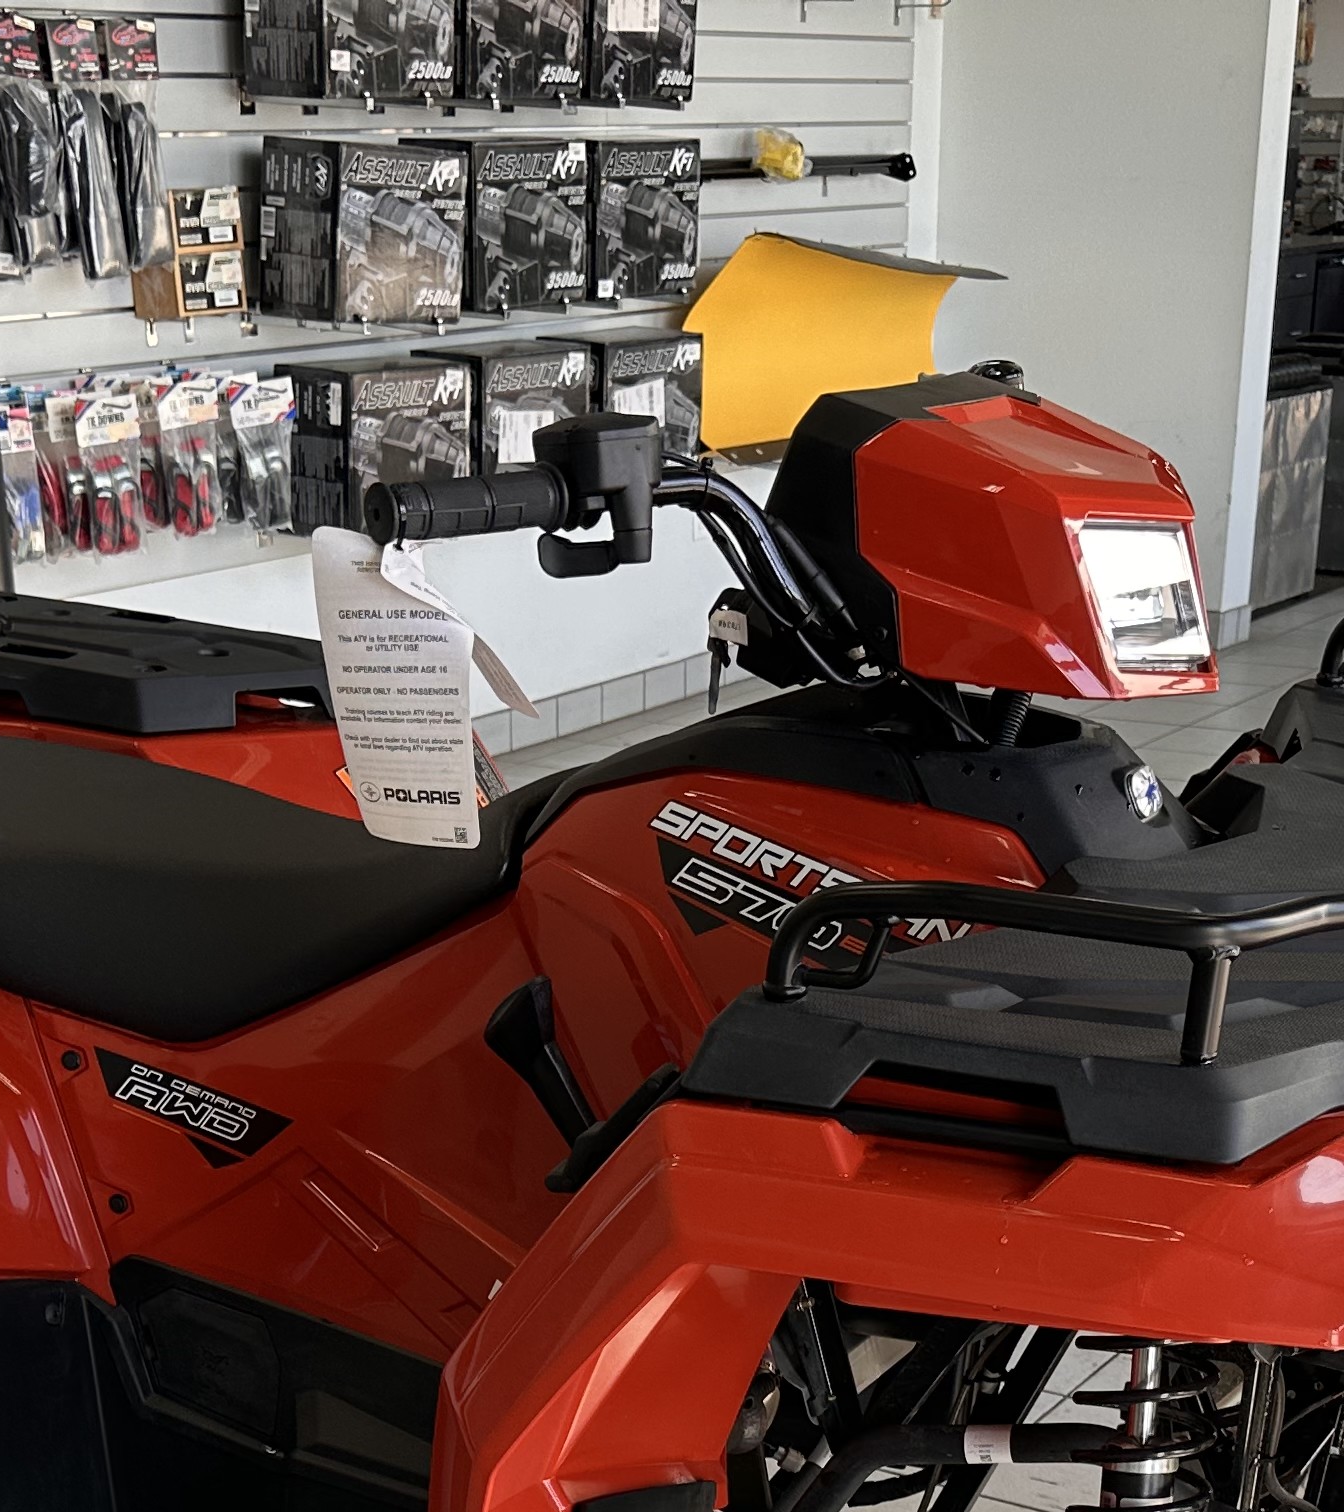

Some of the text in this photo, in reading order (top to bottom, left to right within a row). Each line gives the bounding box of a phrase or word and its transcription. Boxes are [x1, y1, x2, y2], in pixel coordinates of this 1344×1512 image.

[338, 609, 448, 621] GENERAL USE MODEL
[338, 635, 353, 643] This
[388, 635, 448, 643] RECREATIONAL
[375, 644, 402, 652] UTILITY
[342, 665, 352, 673] NO
[337, 687, 371, 695] OPERATOR
[373, 687, 391, 695] ONLY
[383, 787, 461, 805] POLARIS
[130, 1064, 257, 1119] ON DEMAND
[114, 1076, 250, 1142] AWD
